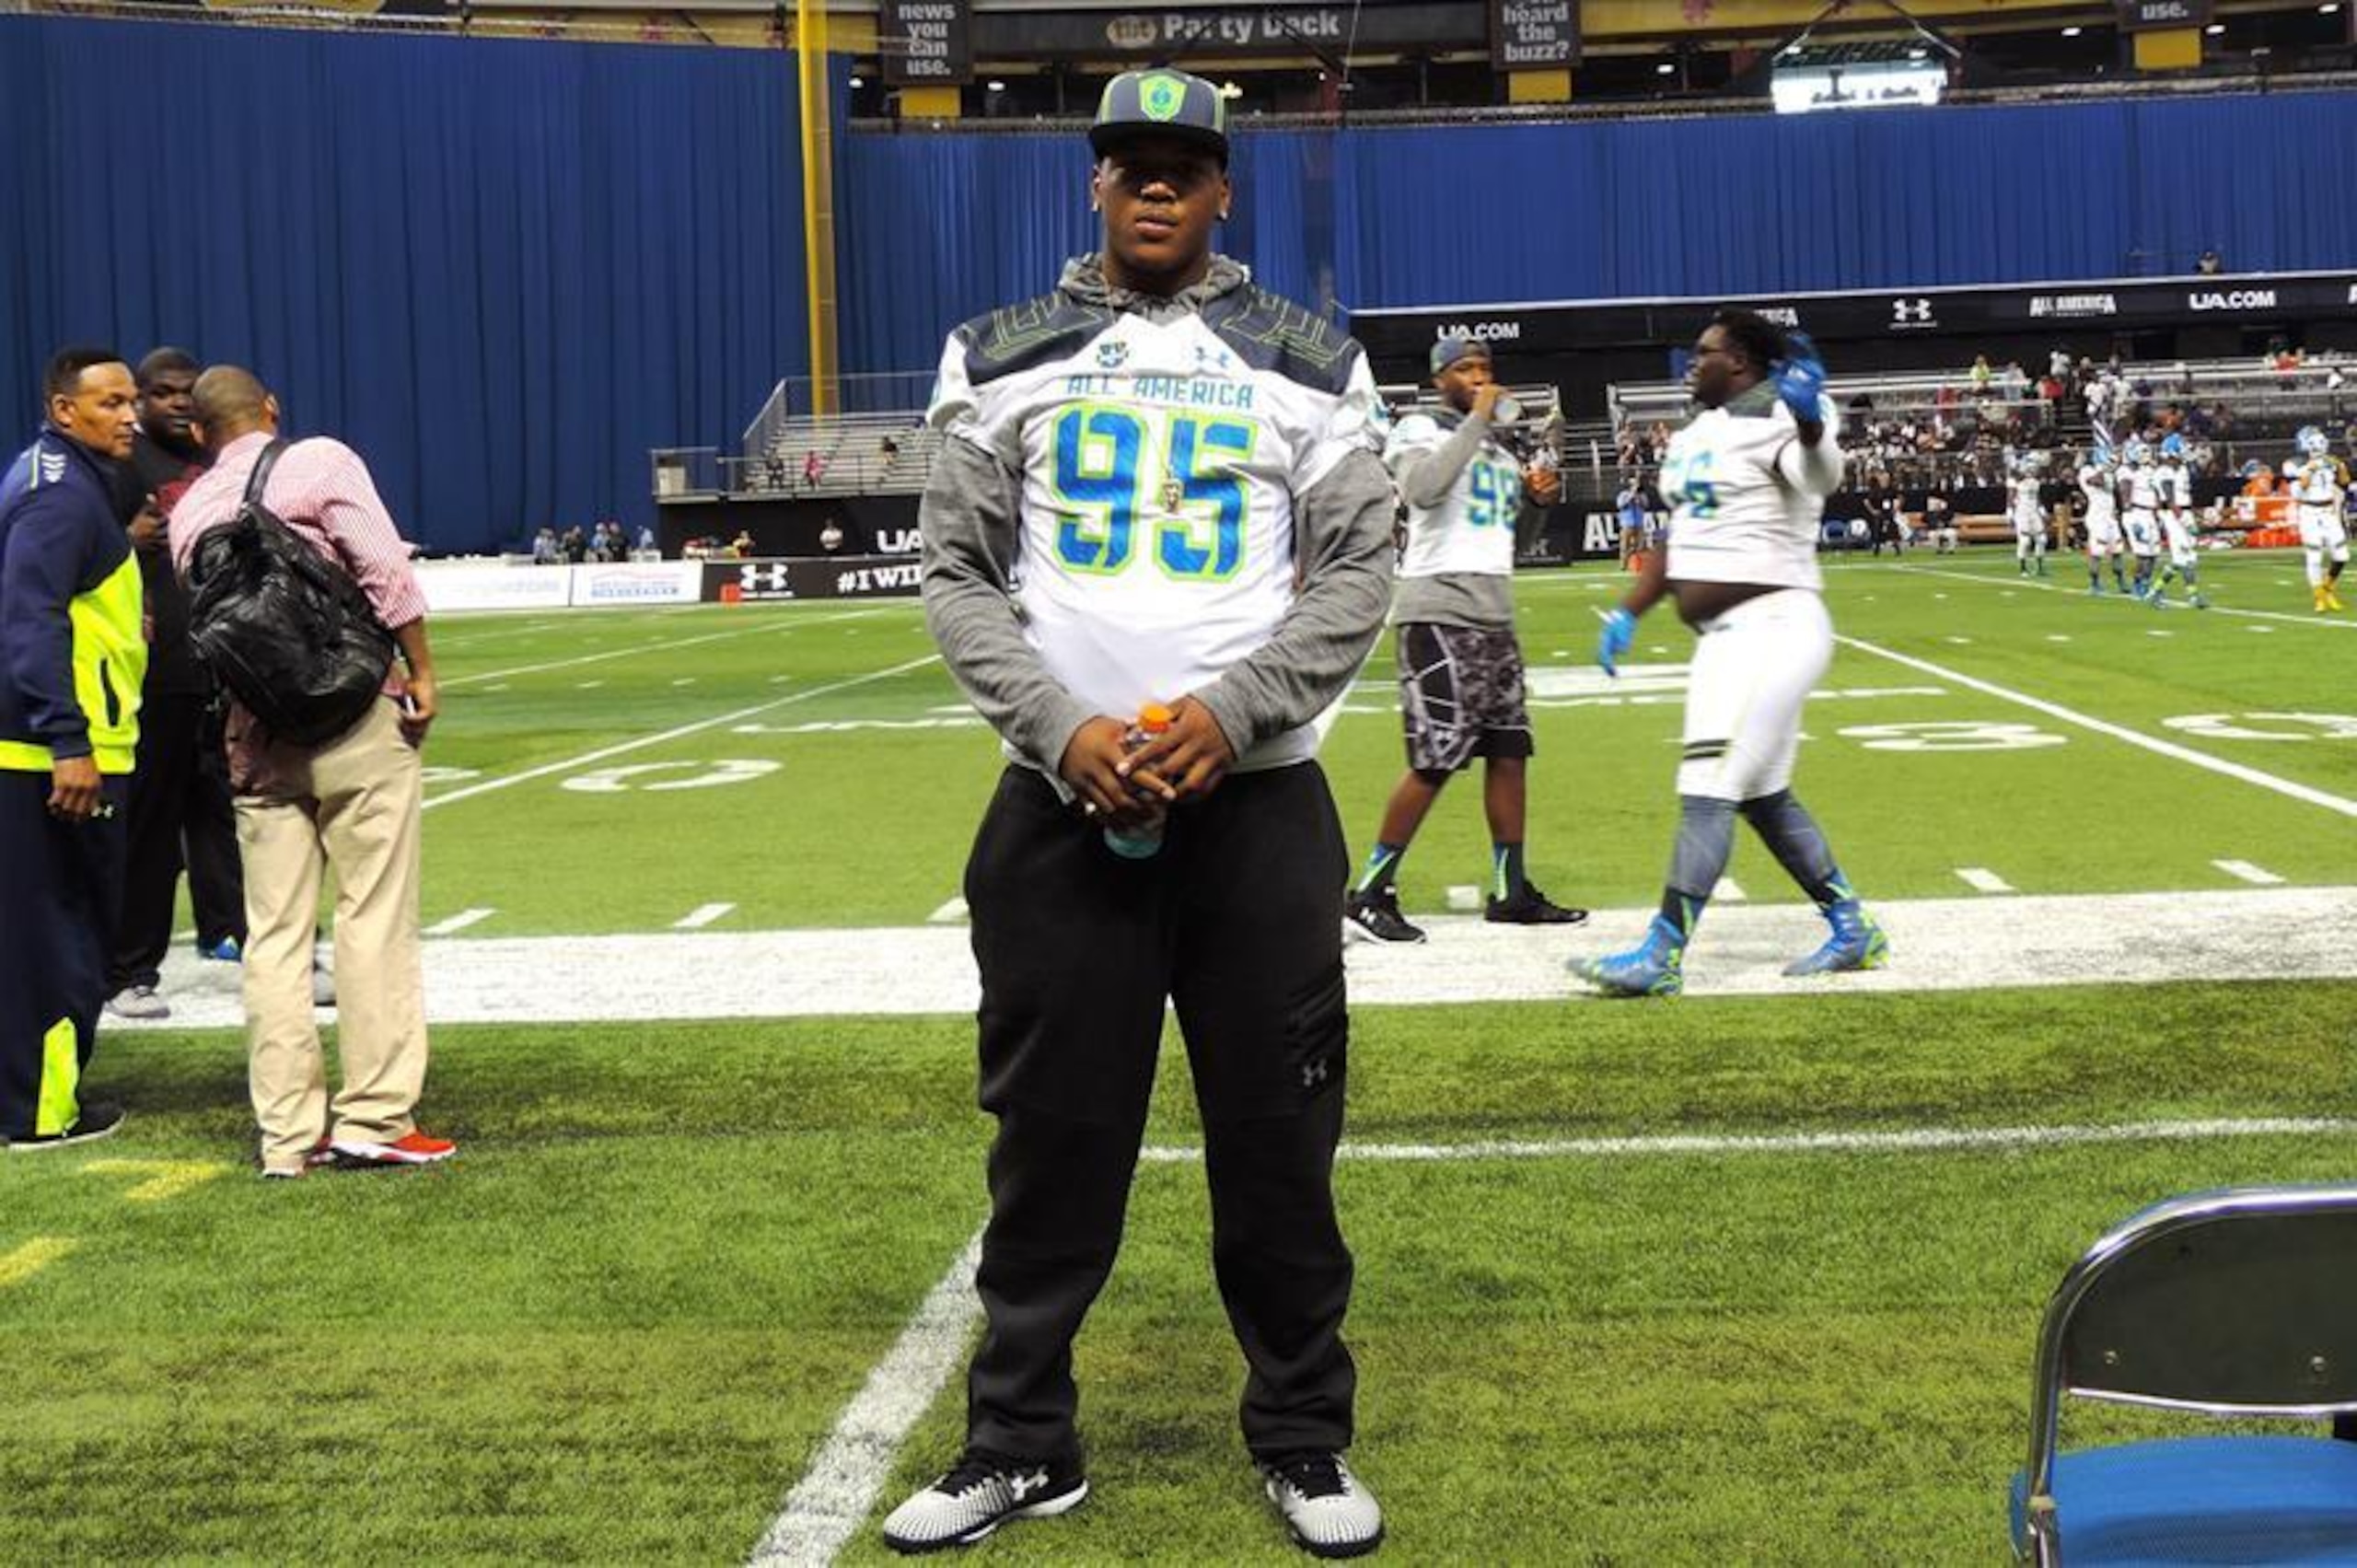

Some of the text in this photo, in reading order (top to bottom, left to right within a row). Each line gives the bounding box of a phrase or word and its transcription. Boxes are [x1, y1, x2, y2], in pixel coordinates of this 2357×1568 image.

[899, 3, 956, 19] news
[1504, 2, 1569, 24] heard
[2142, 2, 2189, 20] use.
[906, 22, 948, 41] you
[1164, 15, 1254, 44] Party
[1262, 10, 1341, 39] Deck
[1517, 23, 1556, 42] the
[909, 41, 948, 56] can
[1504, 41, 1569, 62] buzz?
[906, 59, 952, 75] use.
[2189, 289, 2278, 310] UA.COM
[1067, 373, 1254, 408] ALL AMERICA
[1050, 401, 1259, 582] 95
